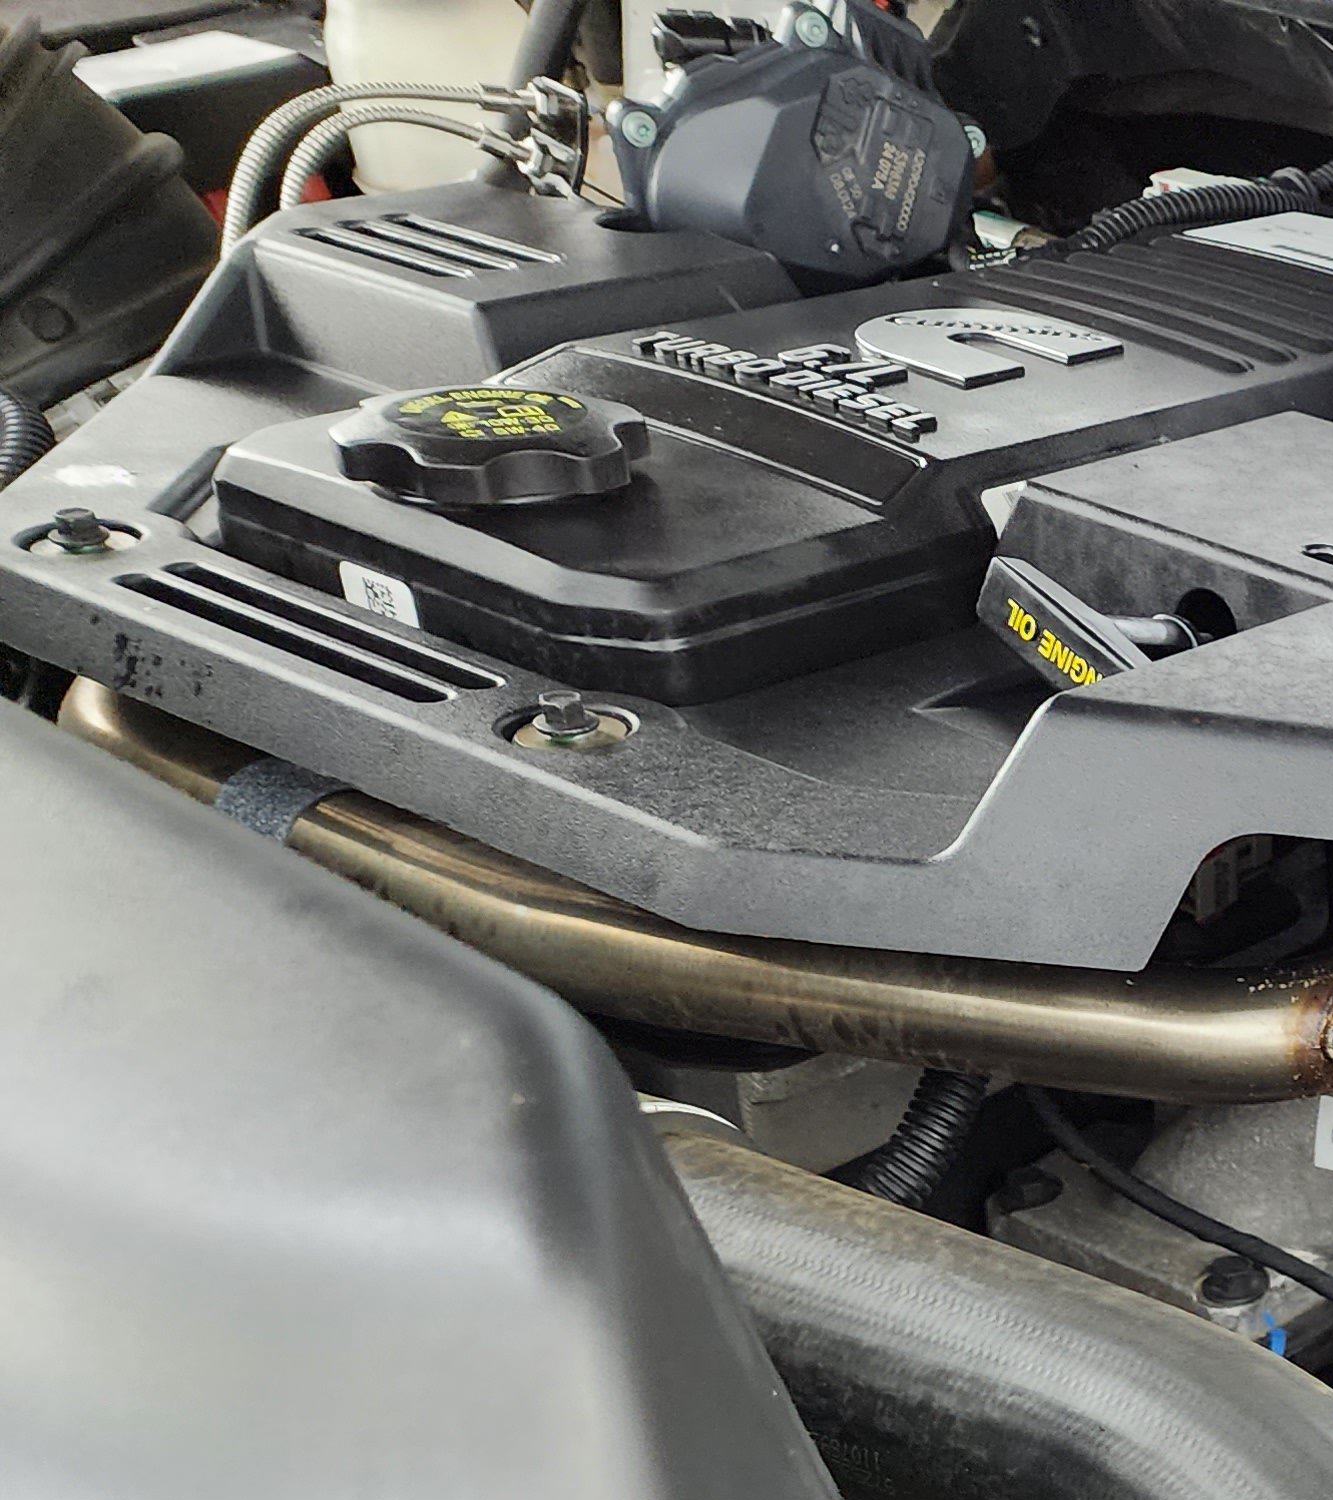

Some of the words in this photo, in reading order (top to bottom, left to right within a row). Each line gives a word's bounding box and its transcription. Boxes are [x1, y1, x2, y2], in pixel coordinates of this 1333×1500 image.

[632, 331, 788, 385] TURBO
[769, 369, 937, 443] DIESEL
[778, 342, 908, 388] 6.7L
[1007, 598, 1039, 641] OIL
[1037, 628, 1103, 687] NGINE
